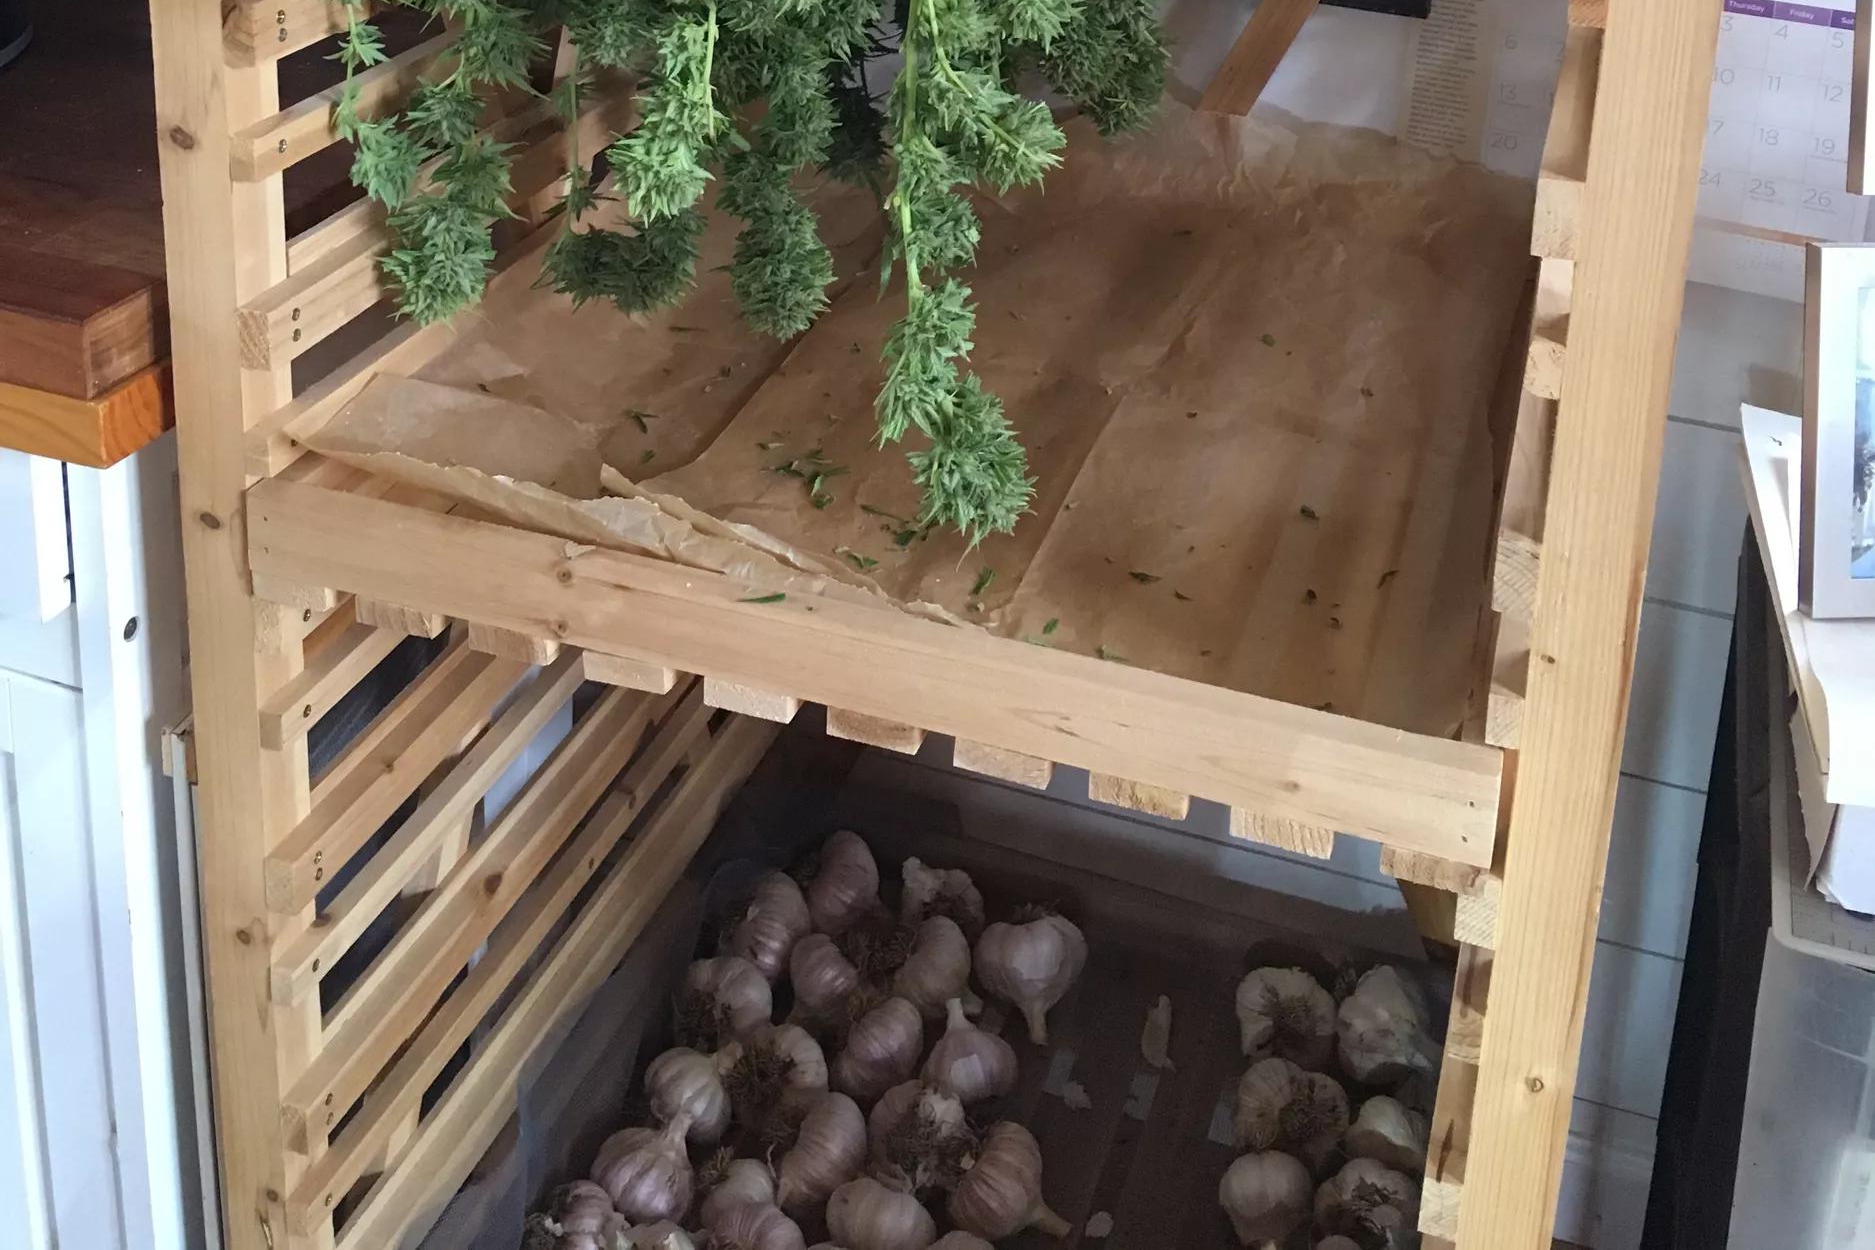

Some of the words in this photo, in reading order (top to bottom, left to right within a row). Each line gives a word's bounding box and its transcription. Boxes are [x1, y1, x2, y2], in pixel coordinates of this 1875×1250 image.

[1728, 0, 1766, 13] Thursday
[1789, 8, 1815, 20] Friday
[1504, 33, 1518, 50] 6
[1721, 16, 1734, 32] 3
[1774, 24, 1789, 40] 4
[1831, 31, 1845, 49] 5
[1500, 83, 1517, 101] 13
[1714, 67, 1735, 85] 10
[1767, 75, 1782, 92] 11
[1822, 84, 1844, 102] 12
[1490, 131, 1518, 150] 20
[1758, 128, 1780, 146] 18
[1813, 137, 1836, 155] 19
[1699, 168, 1721, 188] 24
[1750, 178, 1776, 198] 25
[1803, 187, 1832, 207] 26
